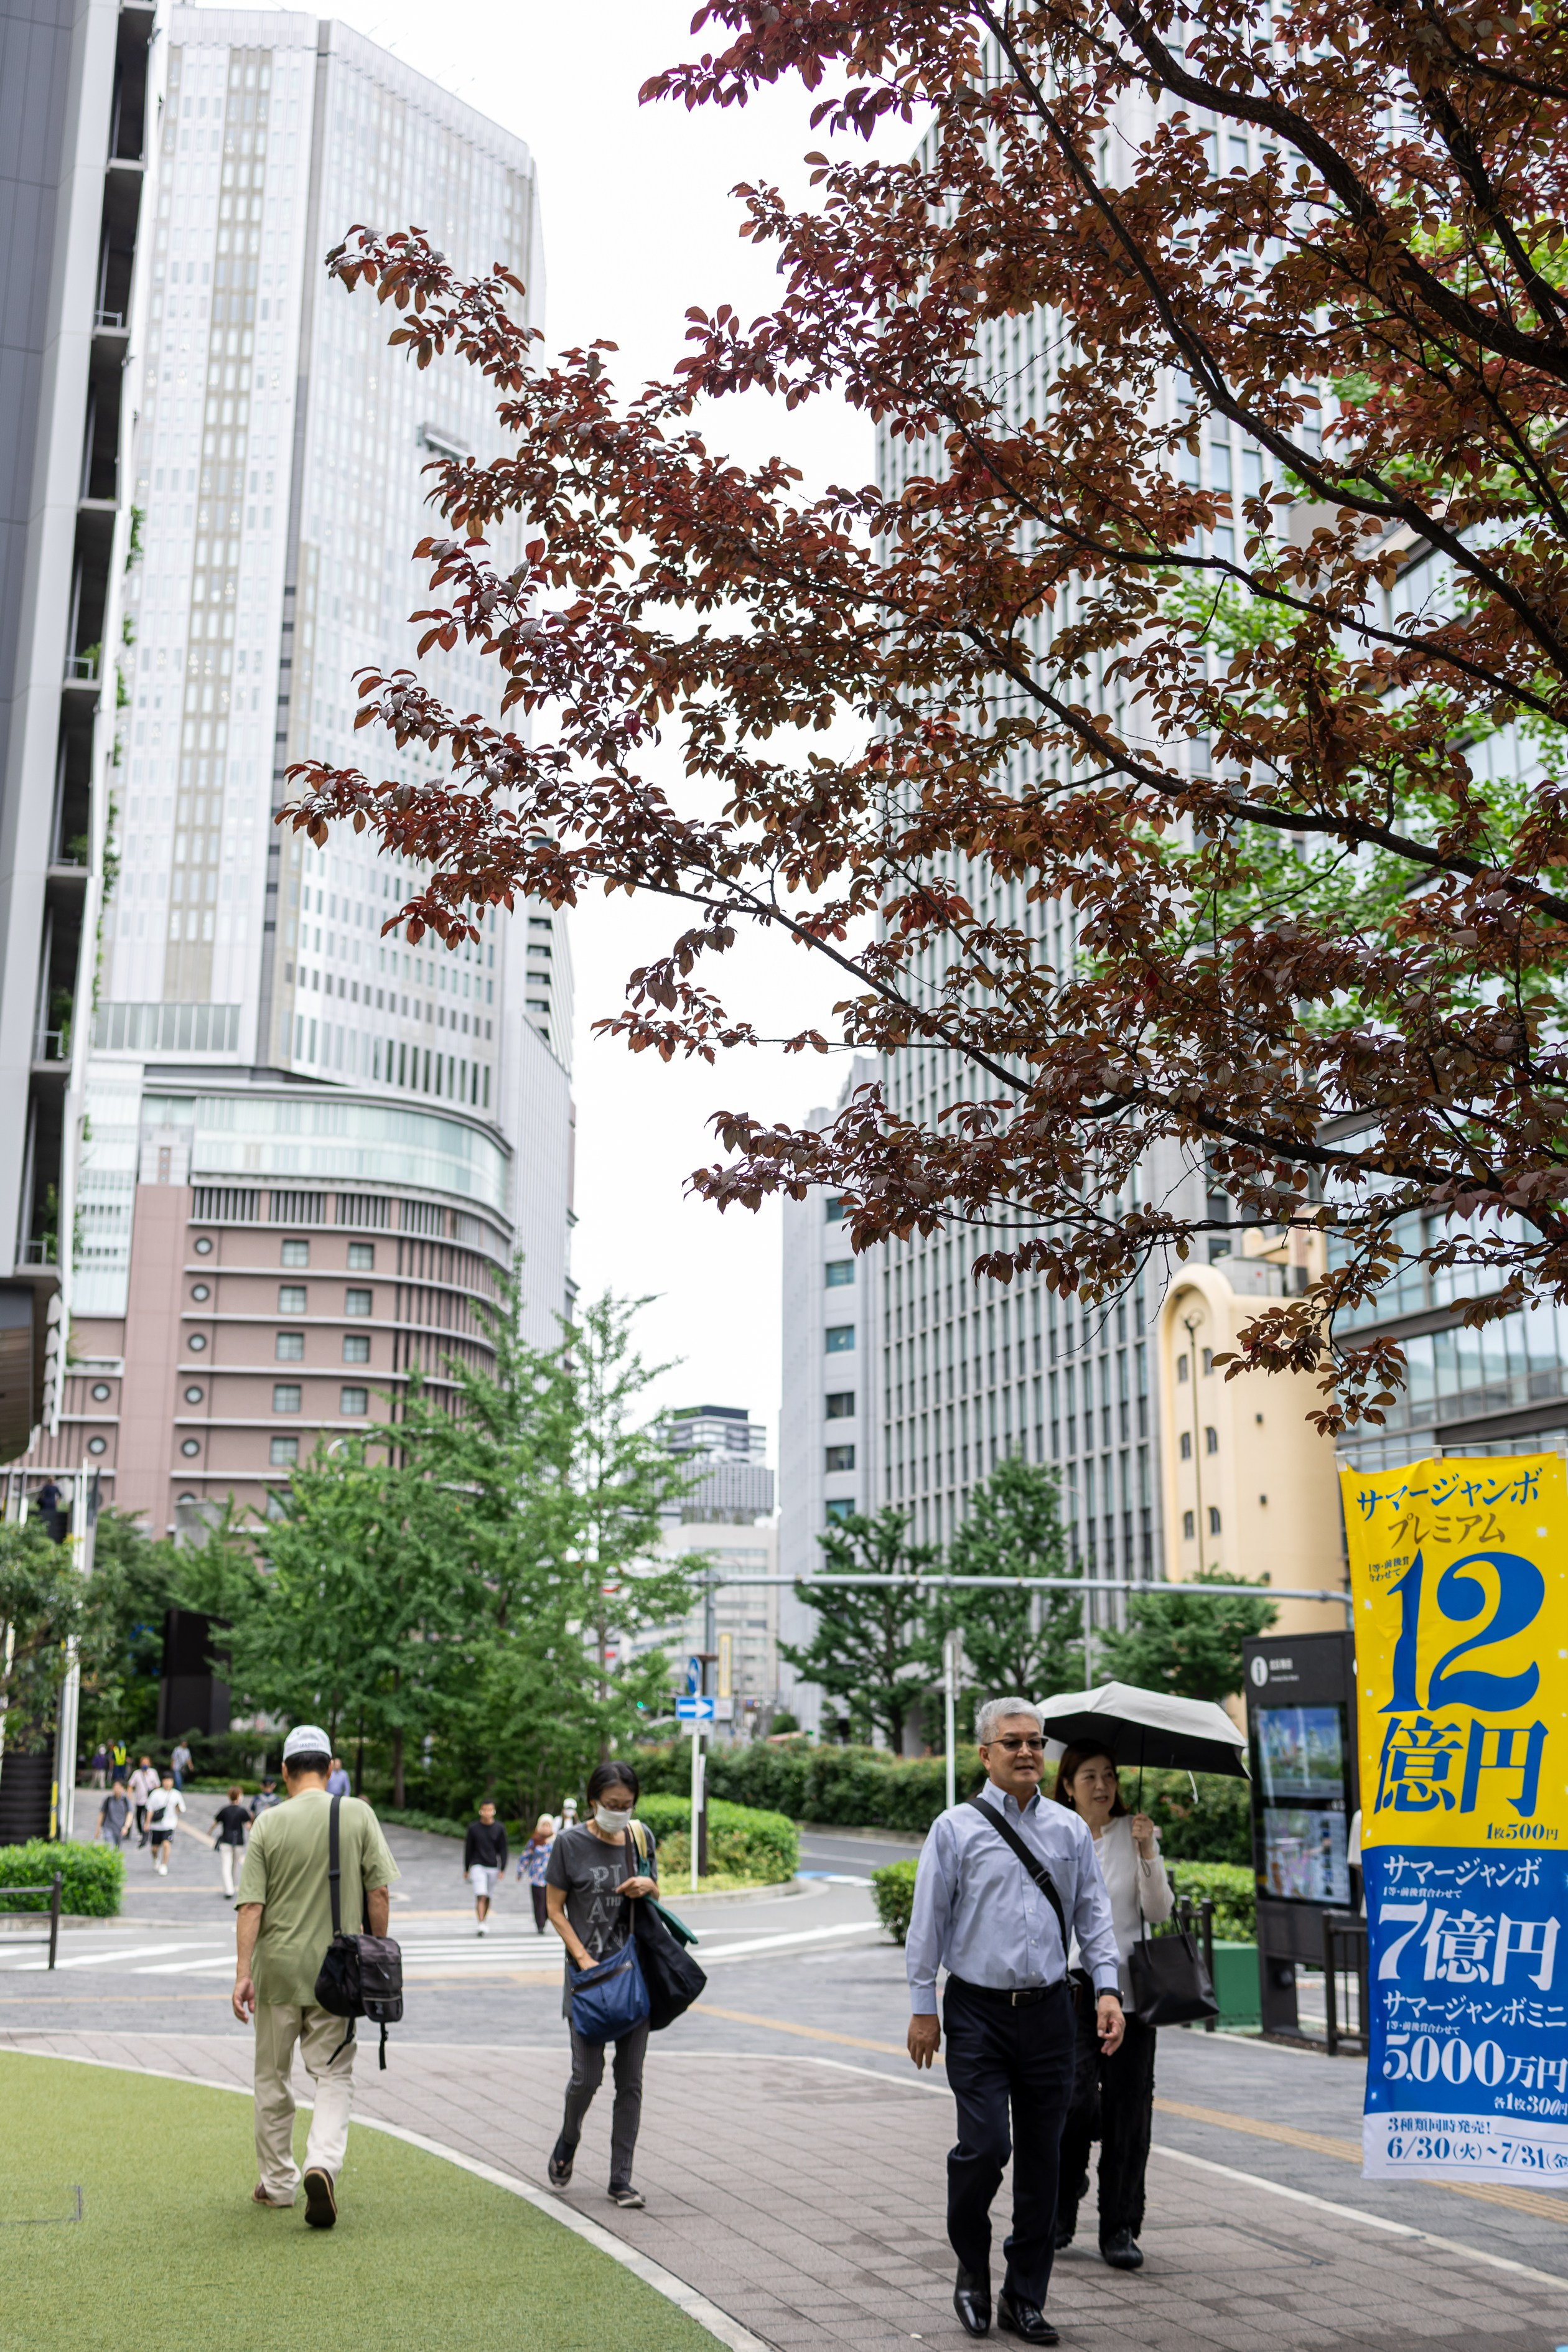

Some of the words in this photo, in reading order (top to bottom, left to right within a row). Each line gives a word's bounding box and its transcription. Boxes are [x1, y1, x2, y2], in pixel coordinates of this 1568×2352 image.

[1356, 1467, 1543, 1522] サマージャンボ
[1388, 1513, 1505, 1549] プレミアム
[1377, 1547, 1546, 1713] 12
[1373, 1715, 1549, 1818] 億円
[1486, 1822, 1559, 1841] 1枚500円
[1383, 1854, 1542, 1888] サマージャンボ
[1377, 1898, 1562, 1991] 7億円
[1382, 1989, 1567, 2028] サマージャンボミニ
[1382, 2032, 1568, 2093] 5,000万円
[1493, 2091, 1568, 2117] 各1枚300円
